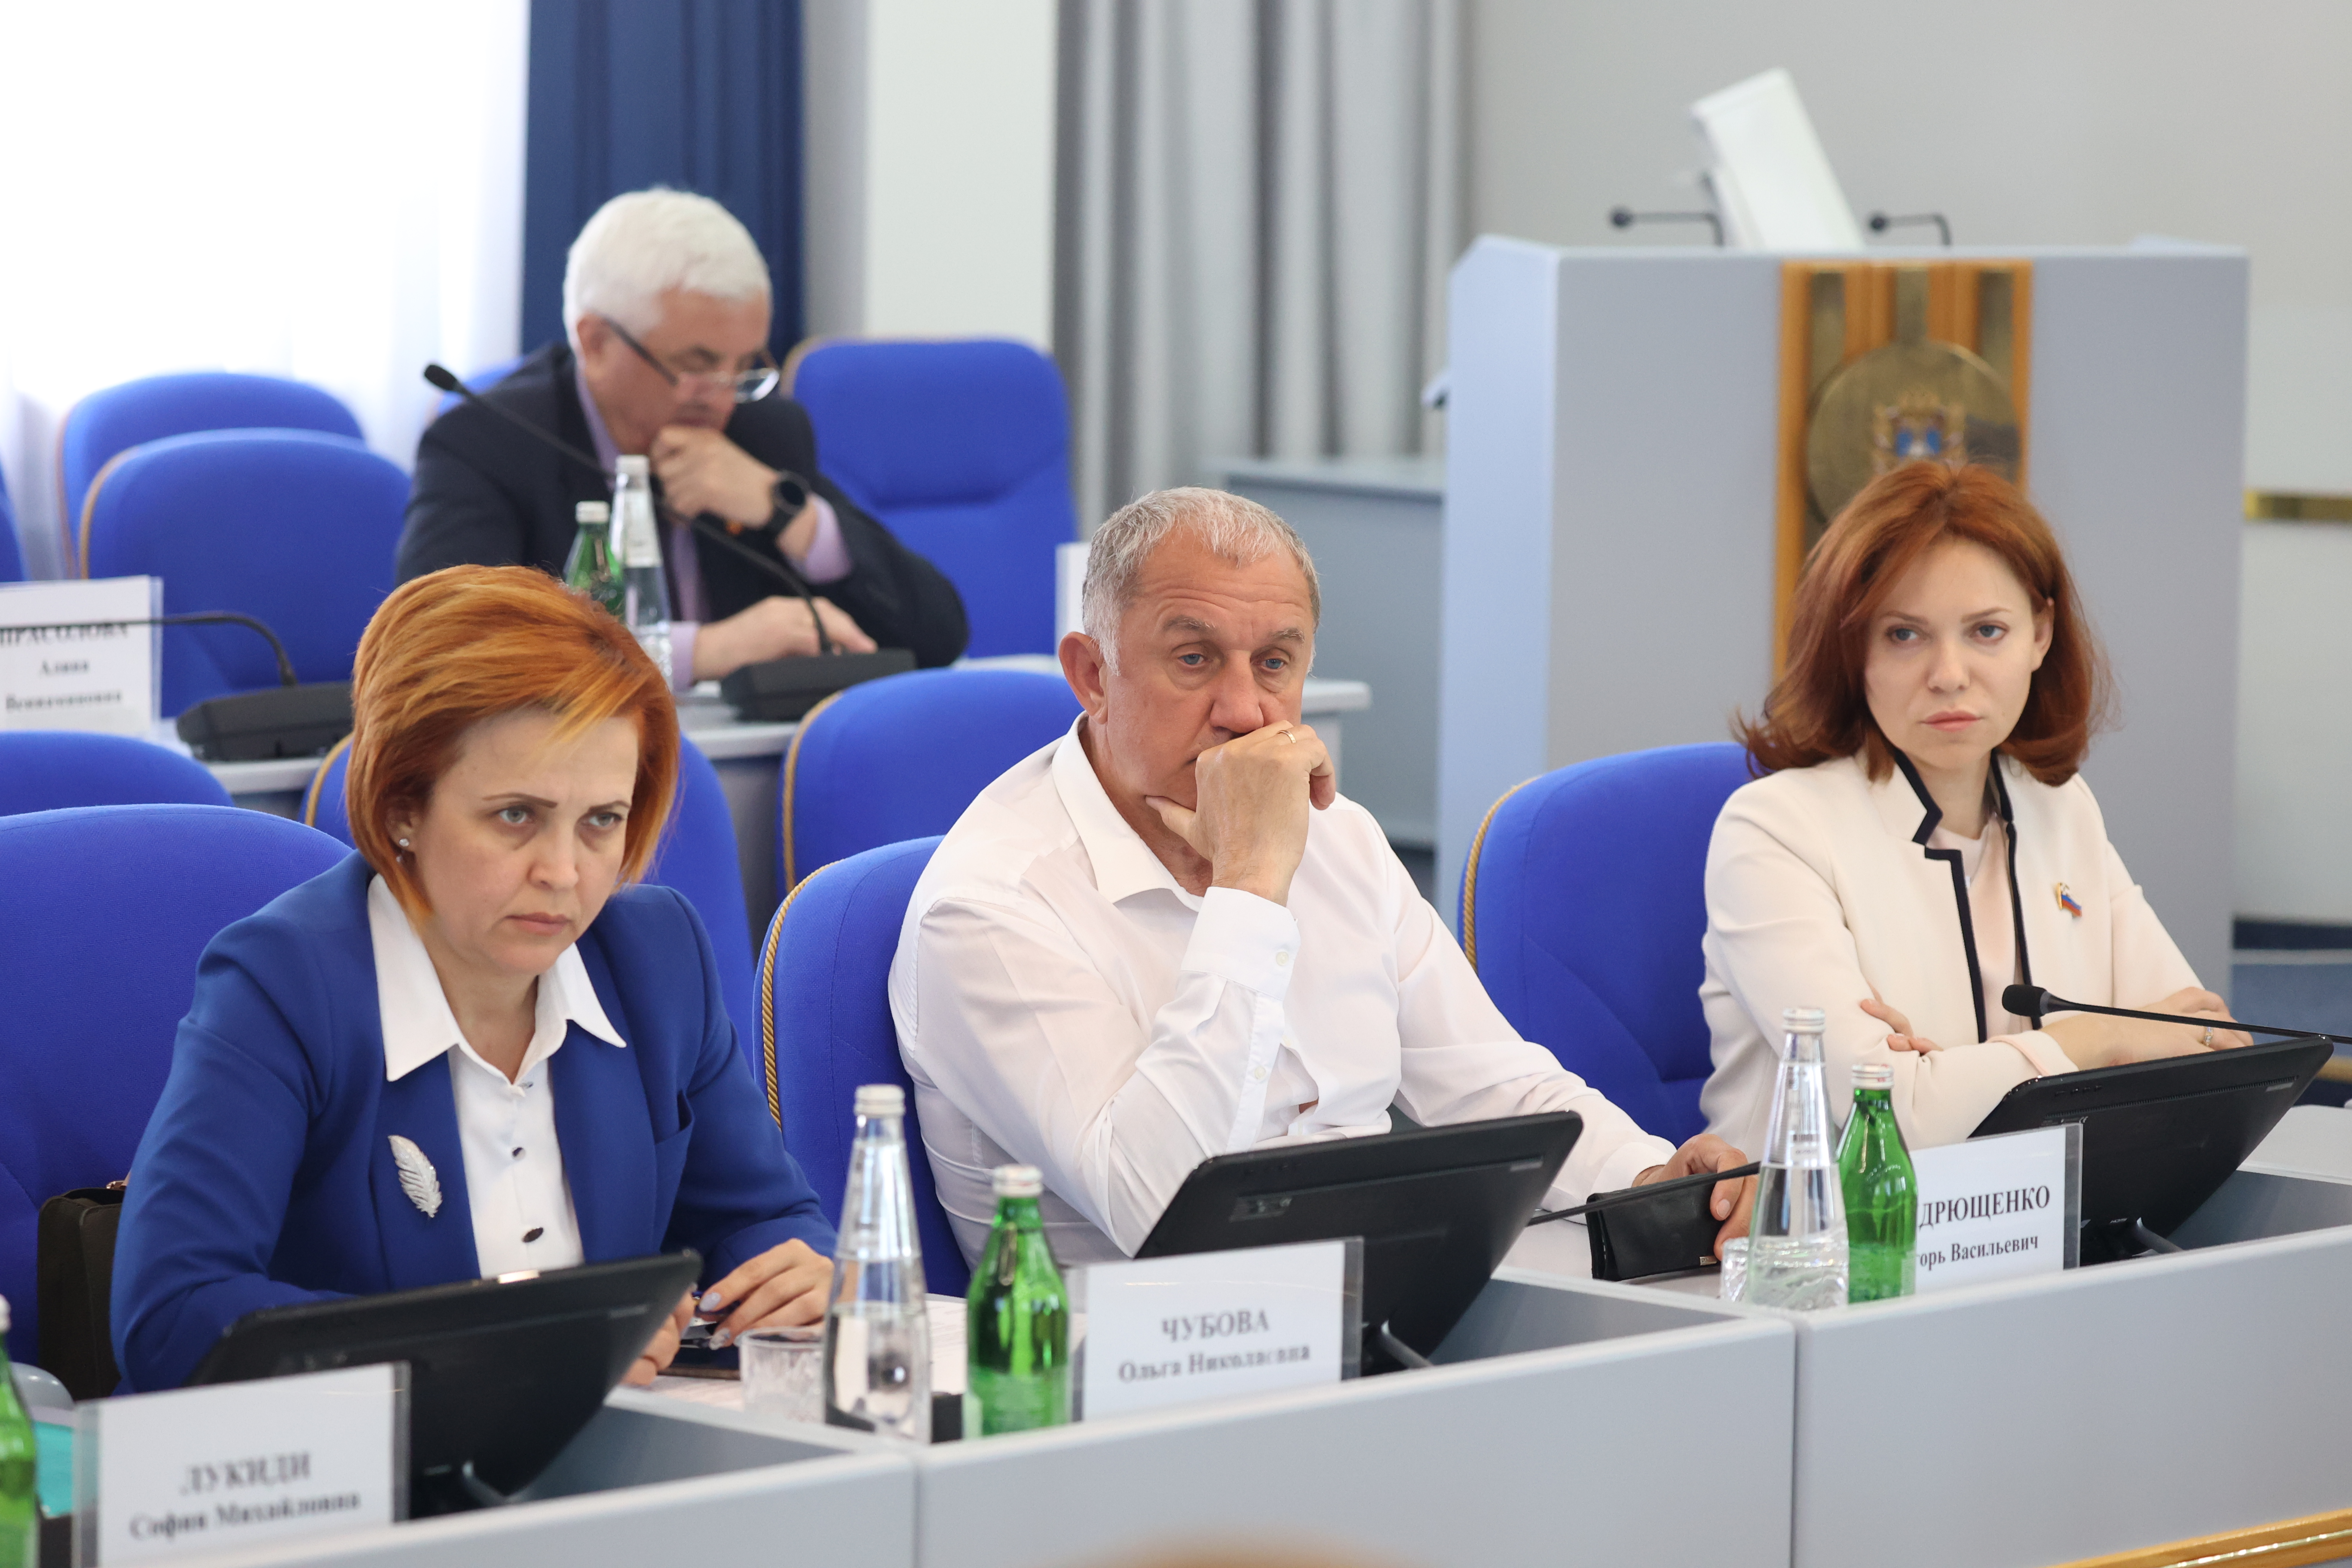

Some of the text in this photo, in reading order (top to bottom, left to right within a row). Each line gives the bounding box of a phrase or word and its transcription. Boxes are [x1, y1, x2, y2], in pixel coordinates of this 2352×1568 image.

[1918, 1185, 2050, 1230] ДРЮЩЕНКО
[1919, 1235, 2039, 1271] орь Васильевич
[1161, 1309, 1270, 1342] ЧУБОВА
[1118, 1345, 1311, 1383] Ольга Николаевна
